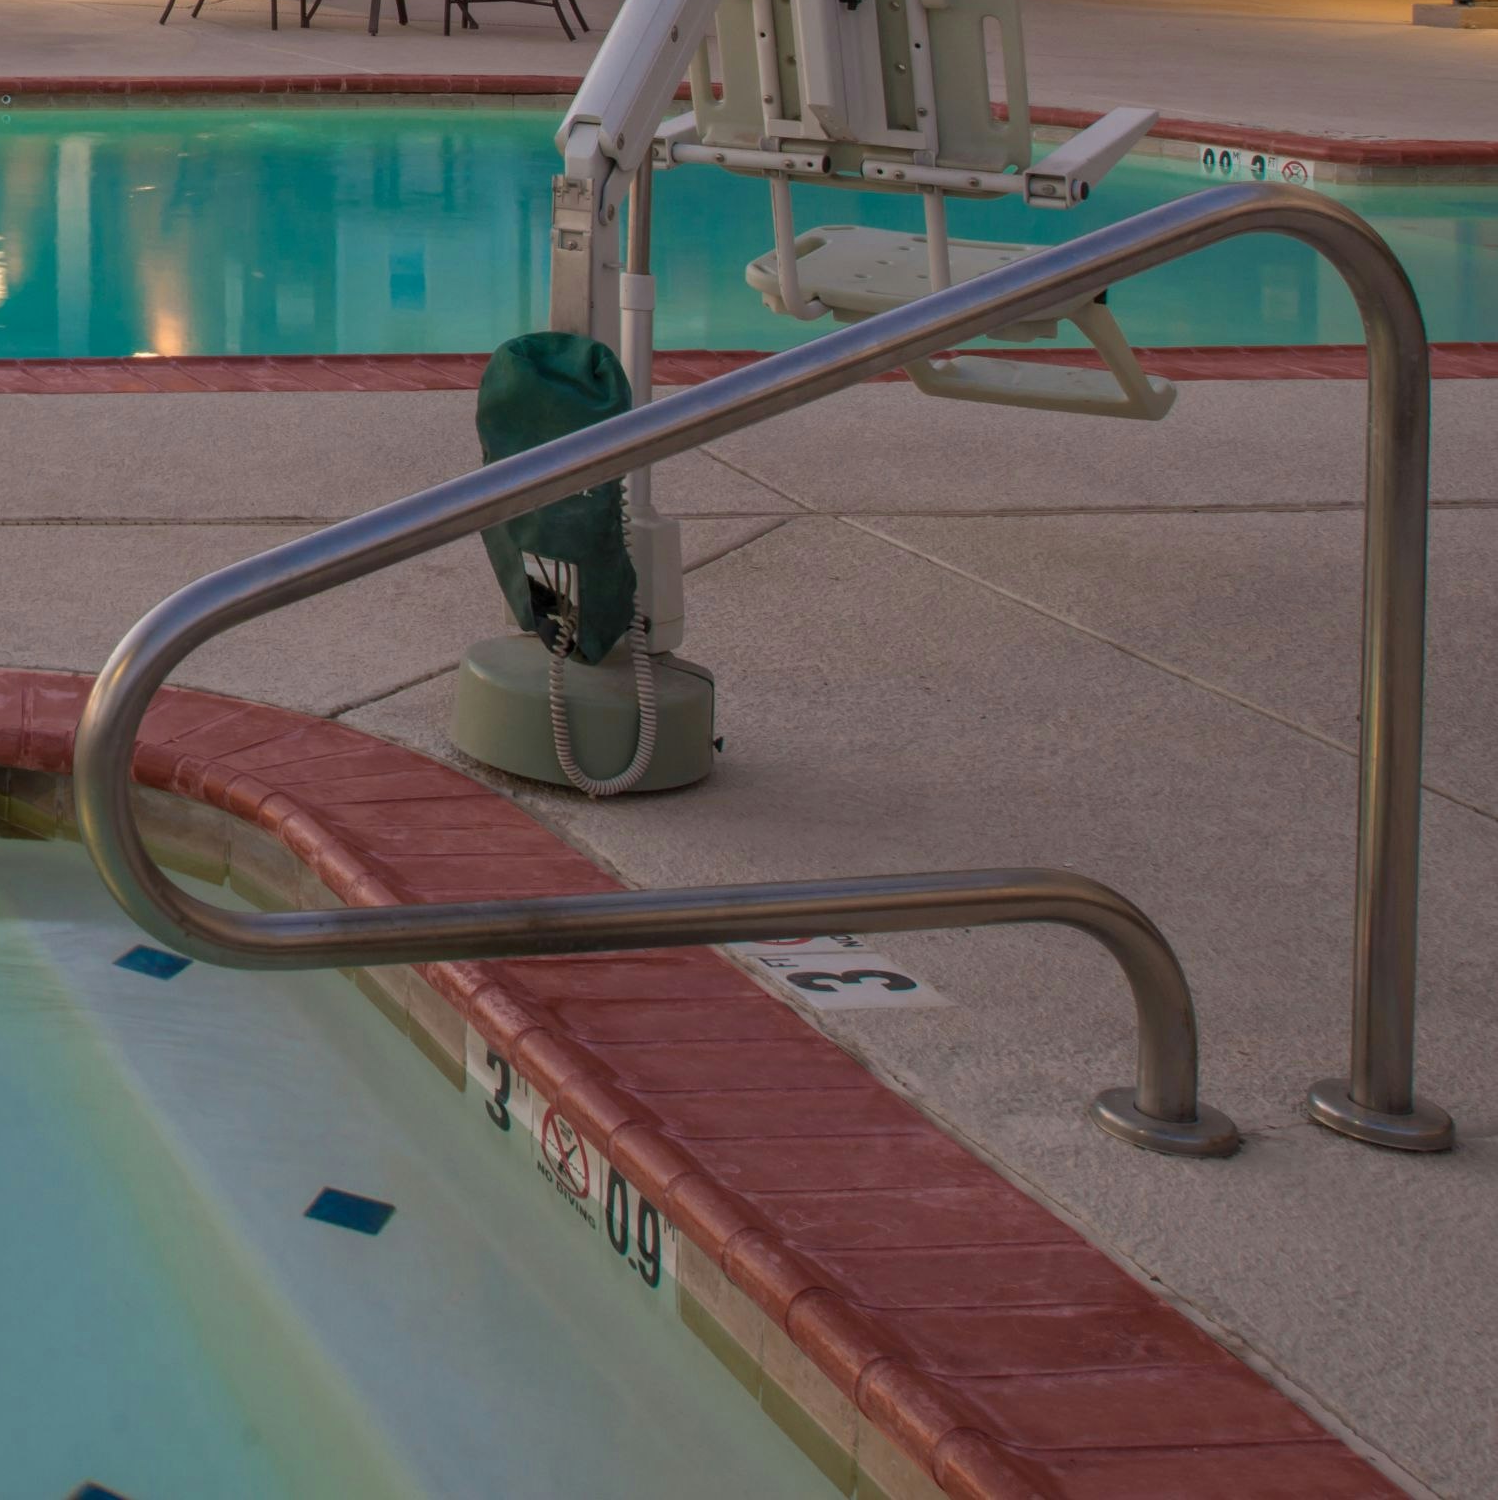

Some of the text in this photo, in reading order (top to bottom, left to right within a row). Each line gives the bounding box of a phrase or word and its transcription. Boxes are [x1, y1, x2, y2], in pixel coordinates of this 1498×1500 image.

[786, 969, 918, 992] 3
[485, 1047, 511, 1132] 3
[537, 1159, 596, 1230] NO DIVING
[605, 1164, 661, 1288] 0.9
